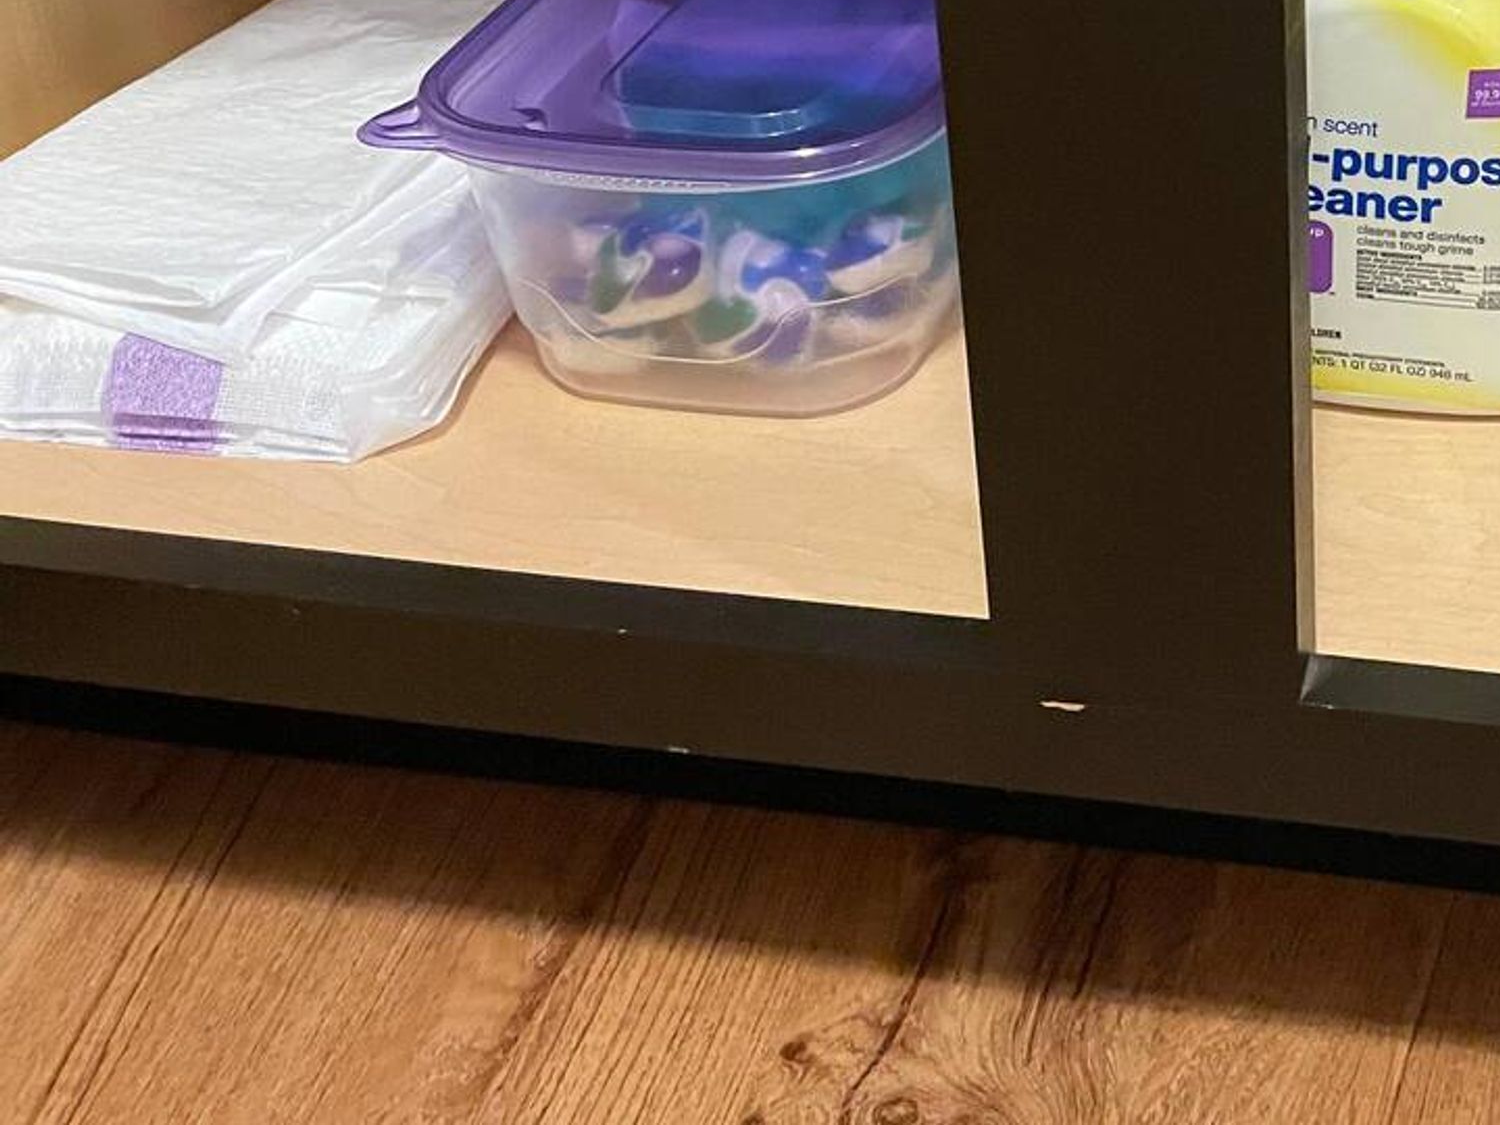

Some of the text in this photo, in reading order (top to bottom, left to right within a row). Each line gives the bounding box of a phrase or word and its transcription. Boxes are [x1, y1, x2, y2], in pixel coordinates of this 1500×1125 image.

[1322, 117, 1378, 138] scent
[1356, 224, 1486, 245] cleans and disinfects
[1356, 236, 1397, 249] cleans
[1399, 240, 1436, 255] tough
[1437, 243, 1475, 256] grime
